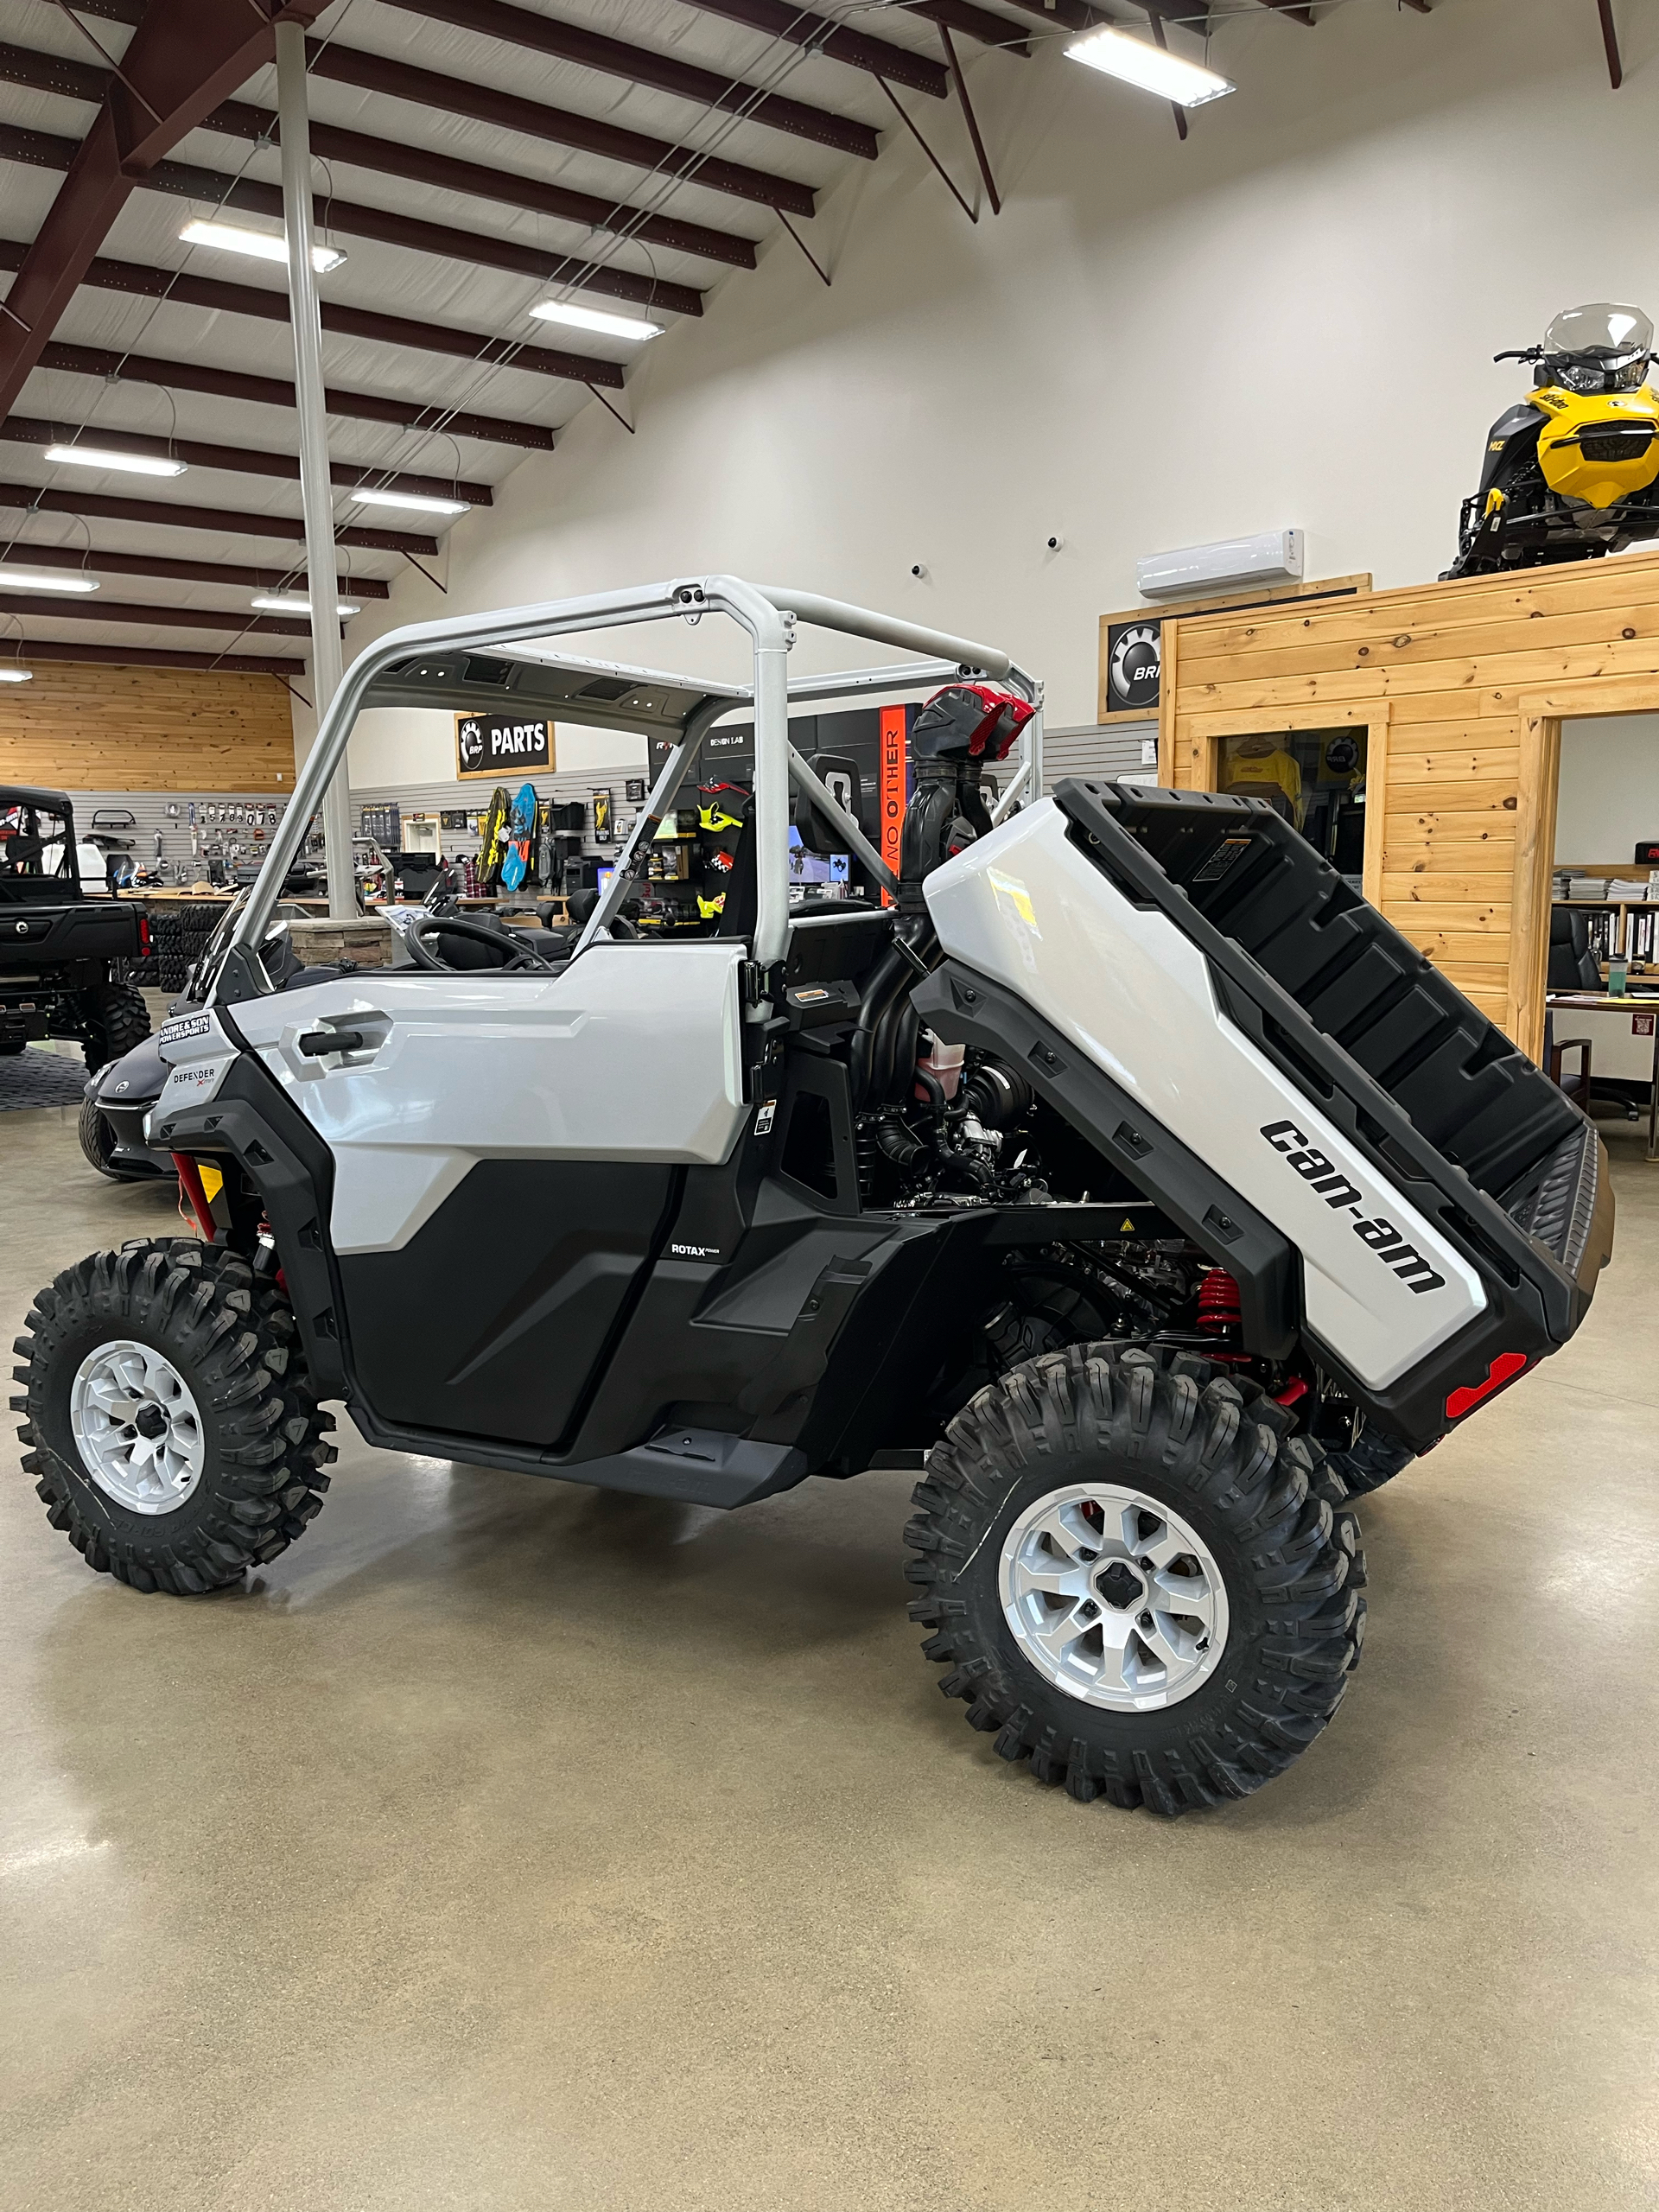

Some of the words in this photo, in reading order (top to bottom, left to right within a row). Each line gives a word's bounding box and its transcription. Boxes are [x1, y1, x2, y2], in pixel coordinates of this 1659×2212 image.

[491, 722, 545, 755] PARTS
[710, 738, 730, 747] DESIGN
[730, 735, 744, 745] LAB
[468, 744, 483, 755] BRP
[887, 730, 899, 817] OTHER
[247, 814, 255, 825] 0
[268, 814, 276, 825] 8
[887, 826, 899, 861] NO
[159, 1025, 209, 1045] POWERSPORTS
[174, 1069, 214, 1084] DEFENDER
[1260, 1120, 1446, 1294] can-am
[671, 1243, 705, 1256] ROTAX
